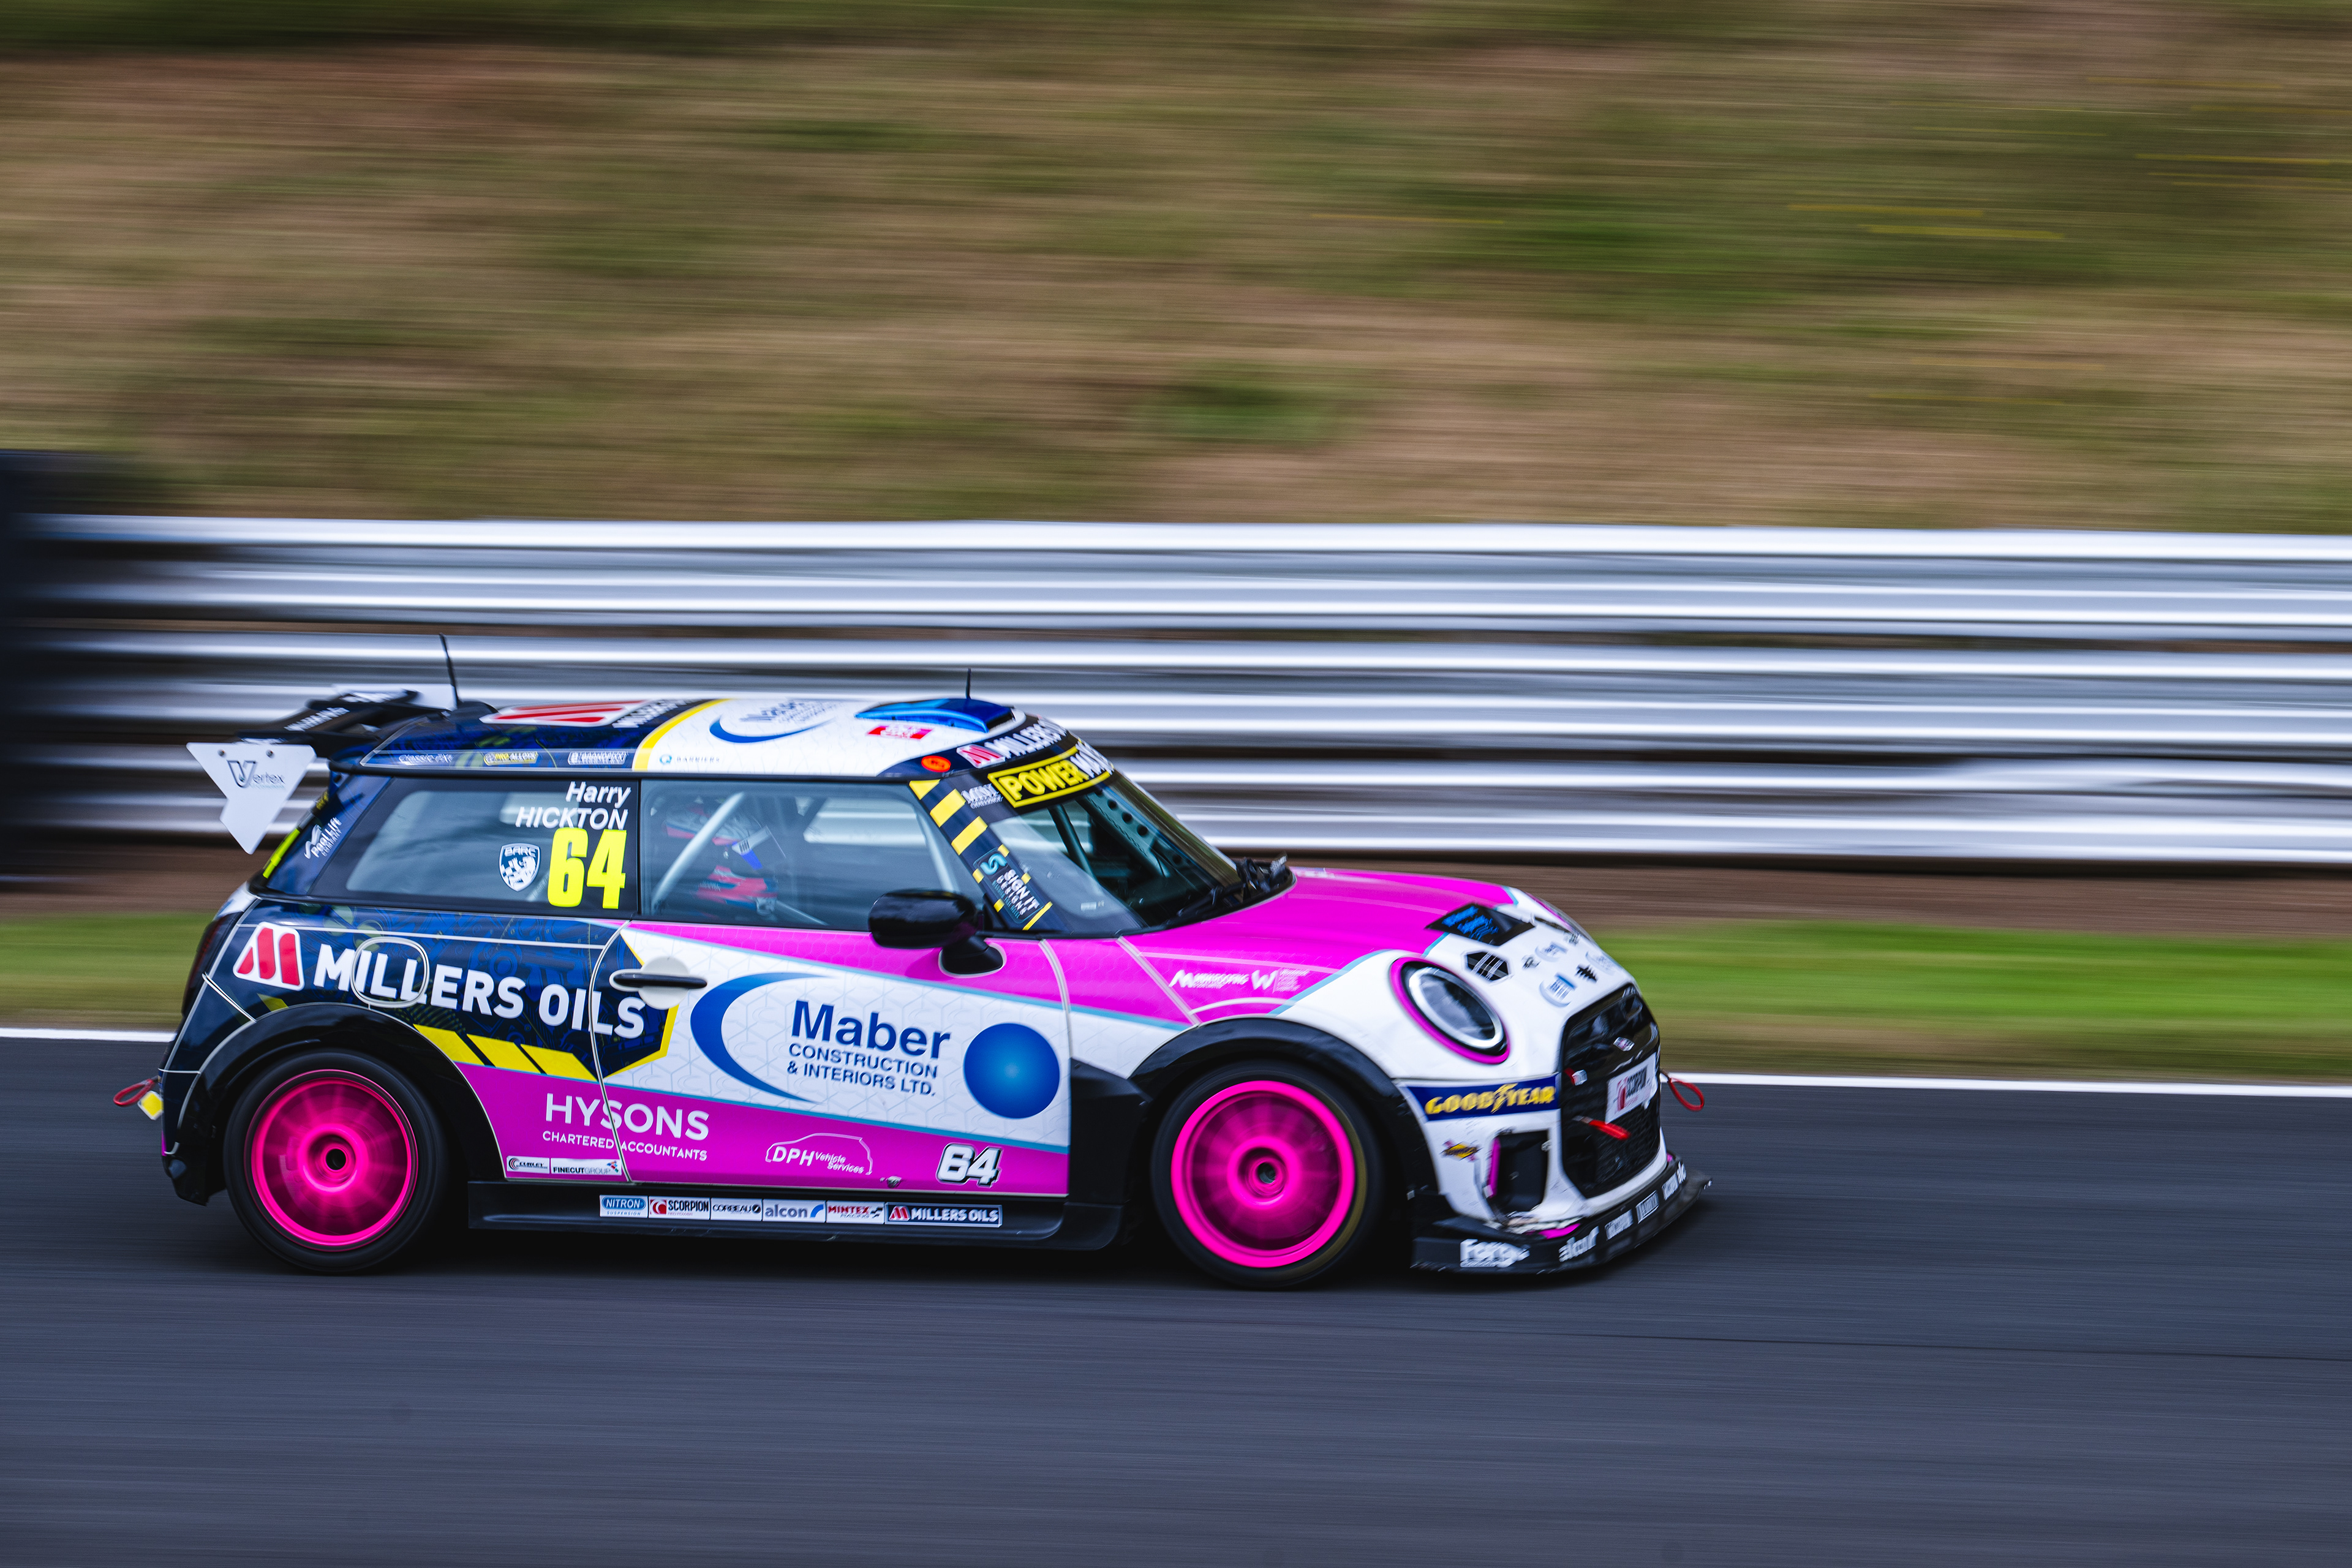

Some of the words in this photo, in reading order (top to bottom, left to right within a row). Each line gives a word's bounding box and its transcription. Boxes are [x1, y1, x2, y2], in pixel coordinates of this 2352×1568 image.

[226, 760, 285, 788] Vertex
[565, 781, 631, 809] Harry
[515, 806, 628, 831] HICKTON
[504, 846, 537, 858] BARC
[547, 827, 627, 910] 64
[1004, 869, 1031, 900] SIGN
[1023, 895, 1040, 911] IT
[314, 943, 526, 1019] MILLERS
[538, 984, 646, 1039] OILS
[791, 1000, 952, 1059] Maber
[788, 1042, 938, 1079] CONSTRUCTION
[786, 1060, 797, 1075] &
[803, 1063, 895, 1090] INTERIORS
[900, 1078, 936, 1096] LTD.
[1424, 1082, 1556, 1115] GOODYEAR
[546, 1093, 710, 1141] HYSONS
[543, 1130, 614, 1149] CHARTERED
[620, 1140, 708, 1162] ACCOUNTANTS
[772, 1145, 816, 1167] DPH
[815, 1151, 846, 1164] Vehicle
[827, 1162, 865, 1175] Services
[936, 1143, 1003, 1188] 64
[606, 1198, 641, 1210] NITRON
[668, 1199, 709, 1212] SCORPION
[712, 1204, 752, 1212] CORBEAU
[765, 1204, 808, 1218] alcon
[828, 1205, 870, 1214] MINTEX
[911, 1208, 968, 1221] MILLERS
[968, 1209, 999, 1223] OILS
